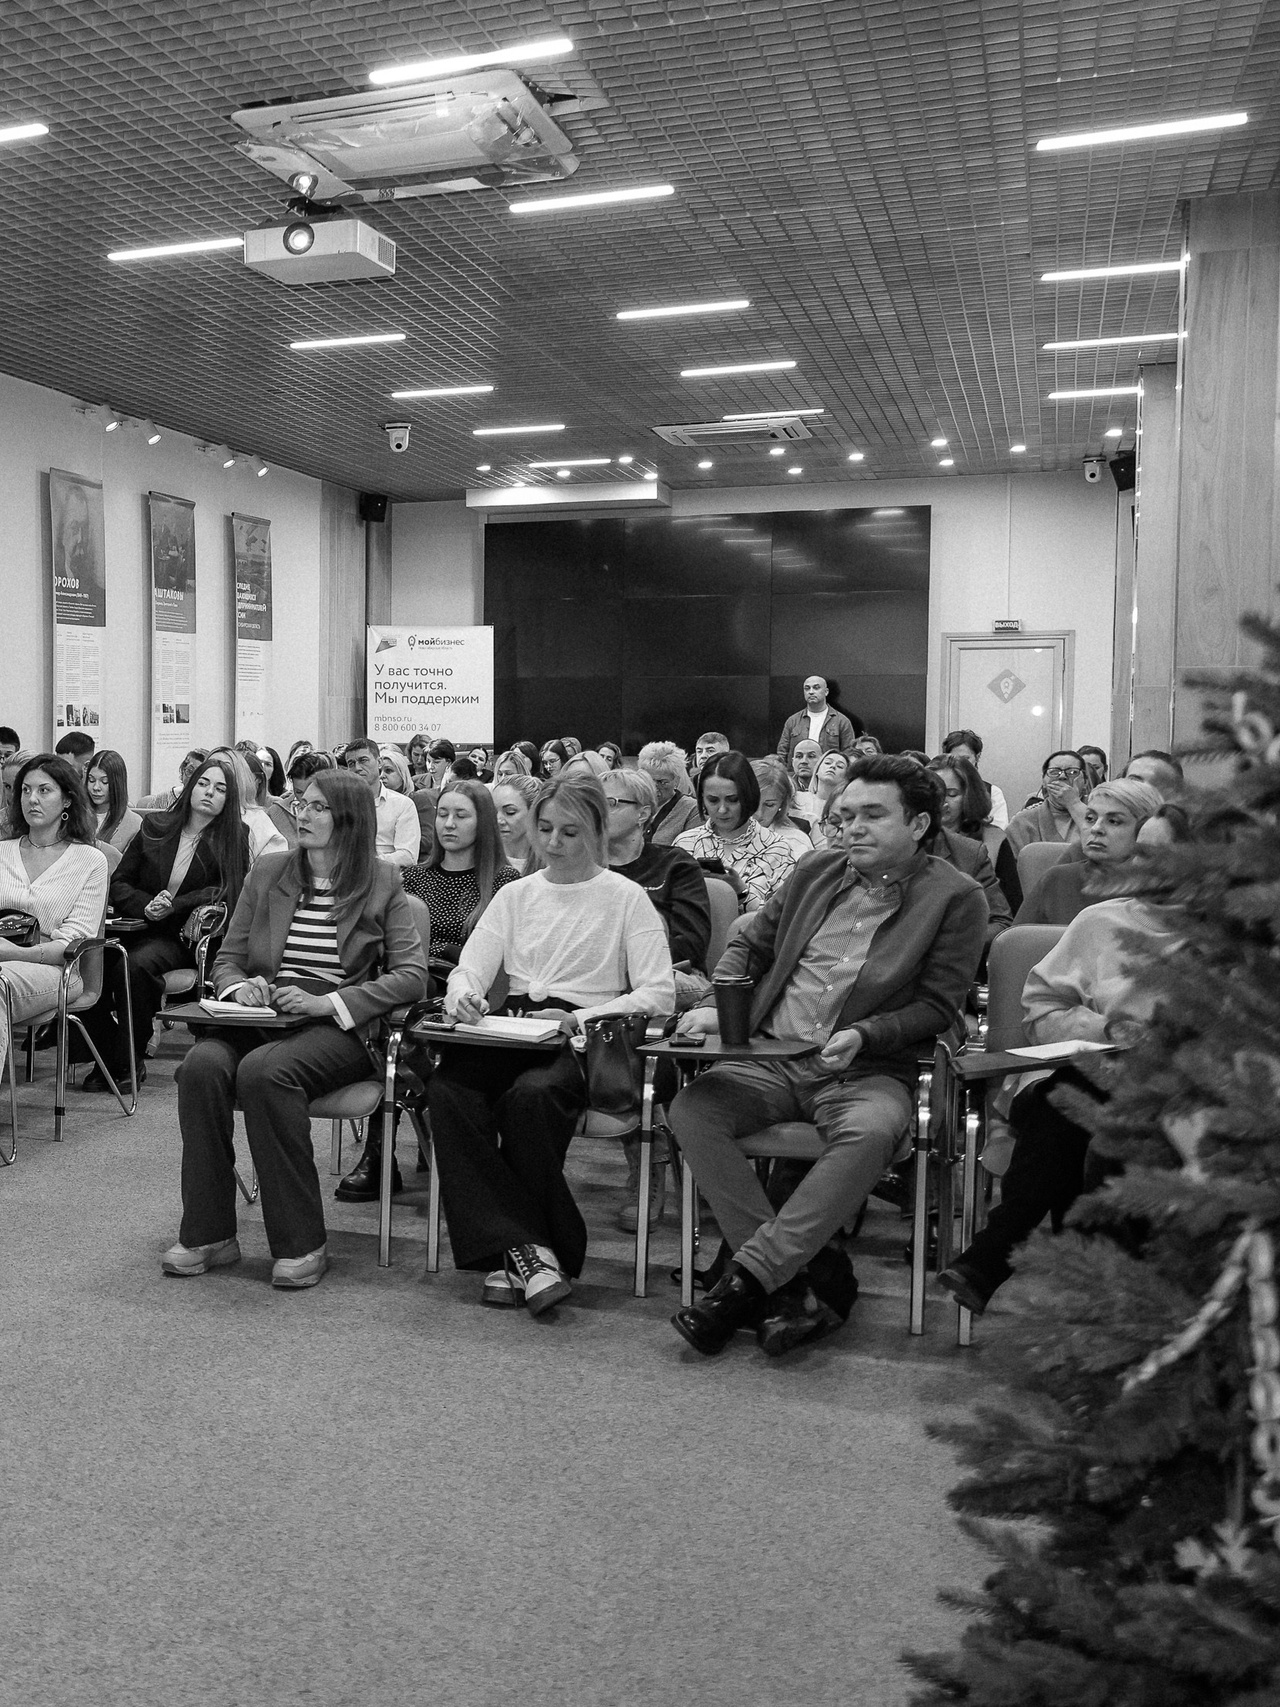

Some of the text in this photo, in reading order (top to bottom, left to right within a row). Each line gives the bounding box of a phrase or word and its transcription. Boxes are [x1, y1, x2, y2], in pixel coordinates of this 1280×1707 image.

[374, 664, 453, 676] У вас точно
[374, 681, 447, 692] получится.
[375, 692, 479, 706] Мы поддержим
[374, 714, 412, 722] mbnso.ru
[374, 724, 441, 732] 8 800 600 34 07
